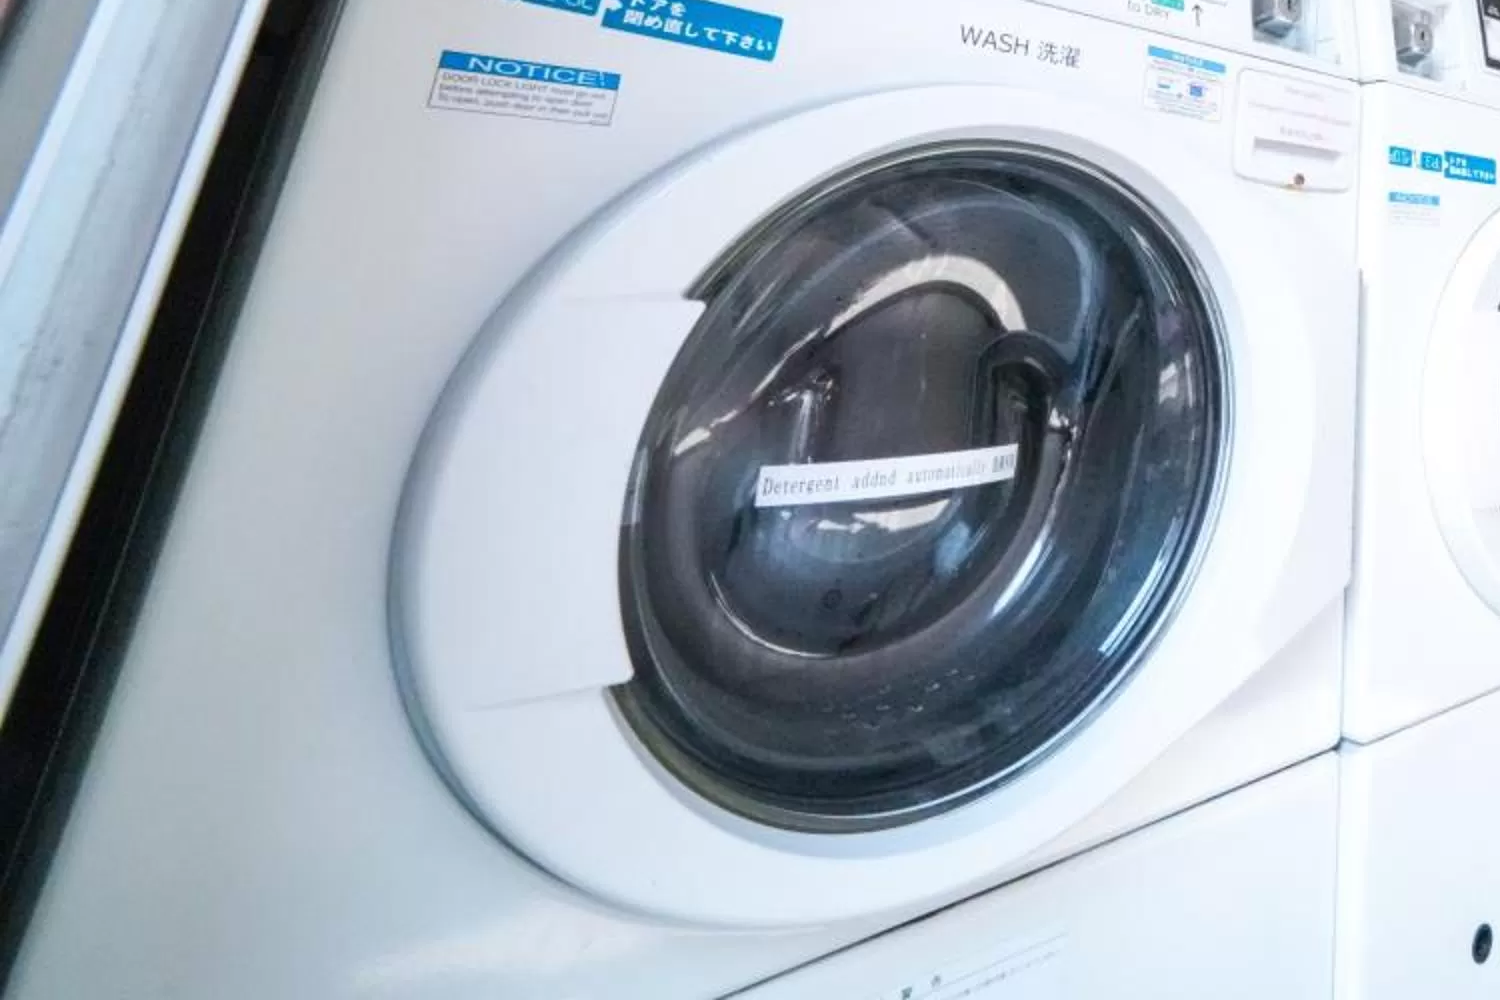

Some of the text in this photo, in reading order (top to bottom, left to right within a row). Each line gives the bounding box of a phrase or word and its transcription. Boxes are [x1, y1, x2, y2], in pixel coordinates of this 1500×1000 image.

[622, 9, 774, 53] 閉め直して下さい
[960, 23, 1081, 69] WASH 洗濯
[467, 55, 606, 89] NOTICE!
[762, 474, 840, 498] Detergent
